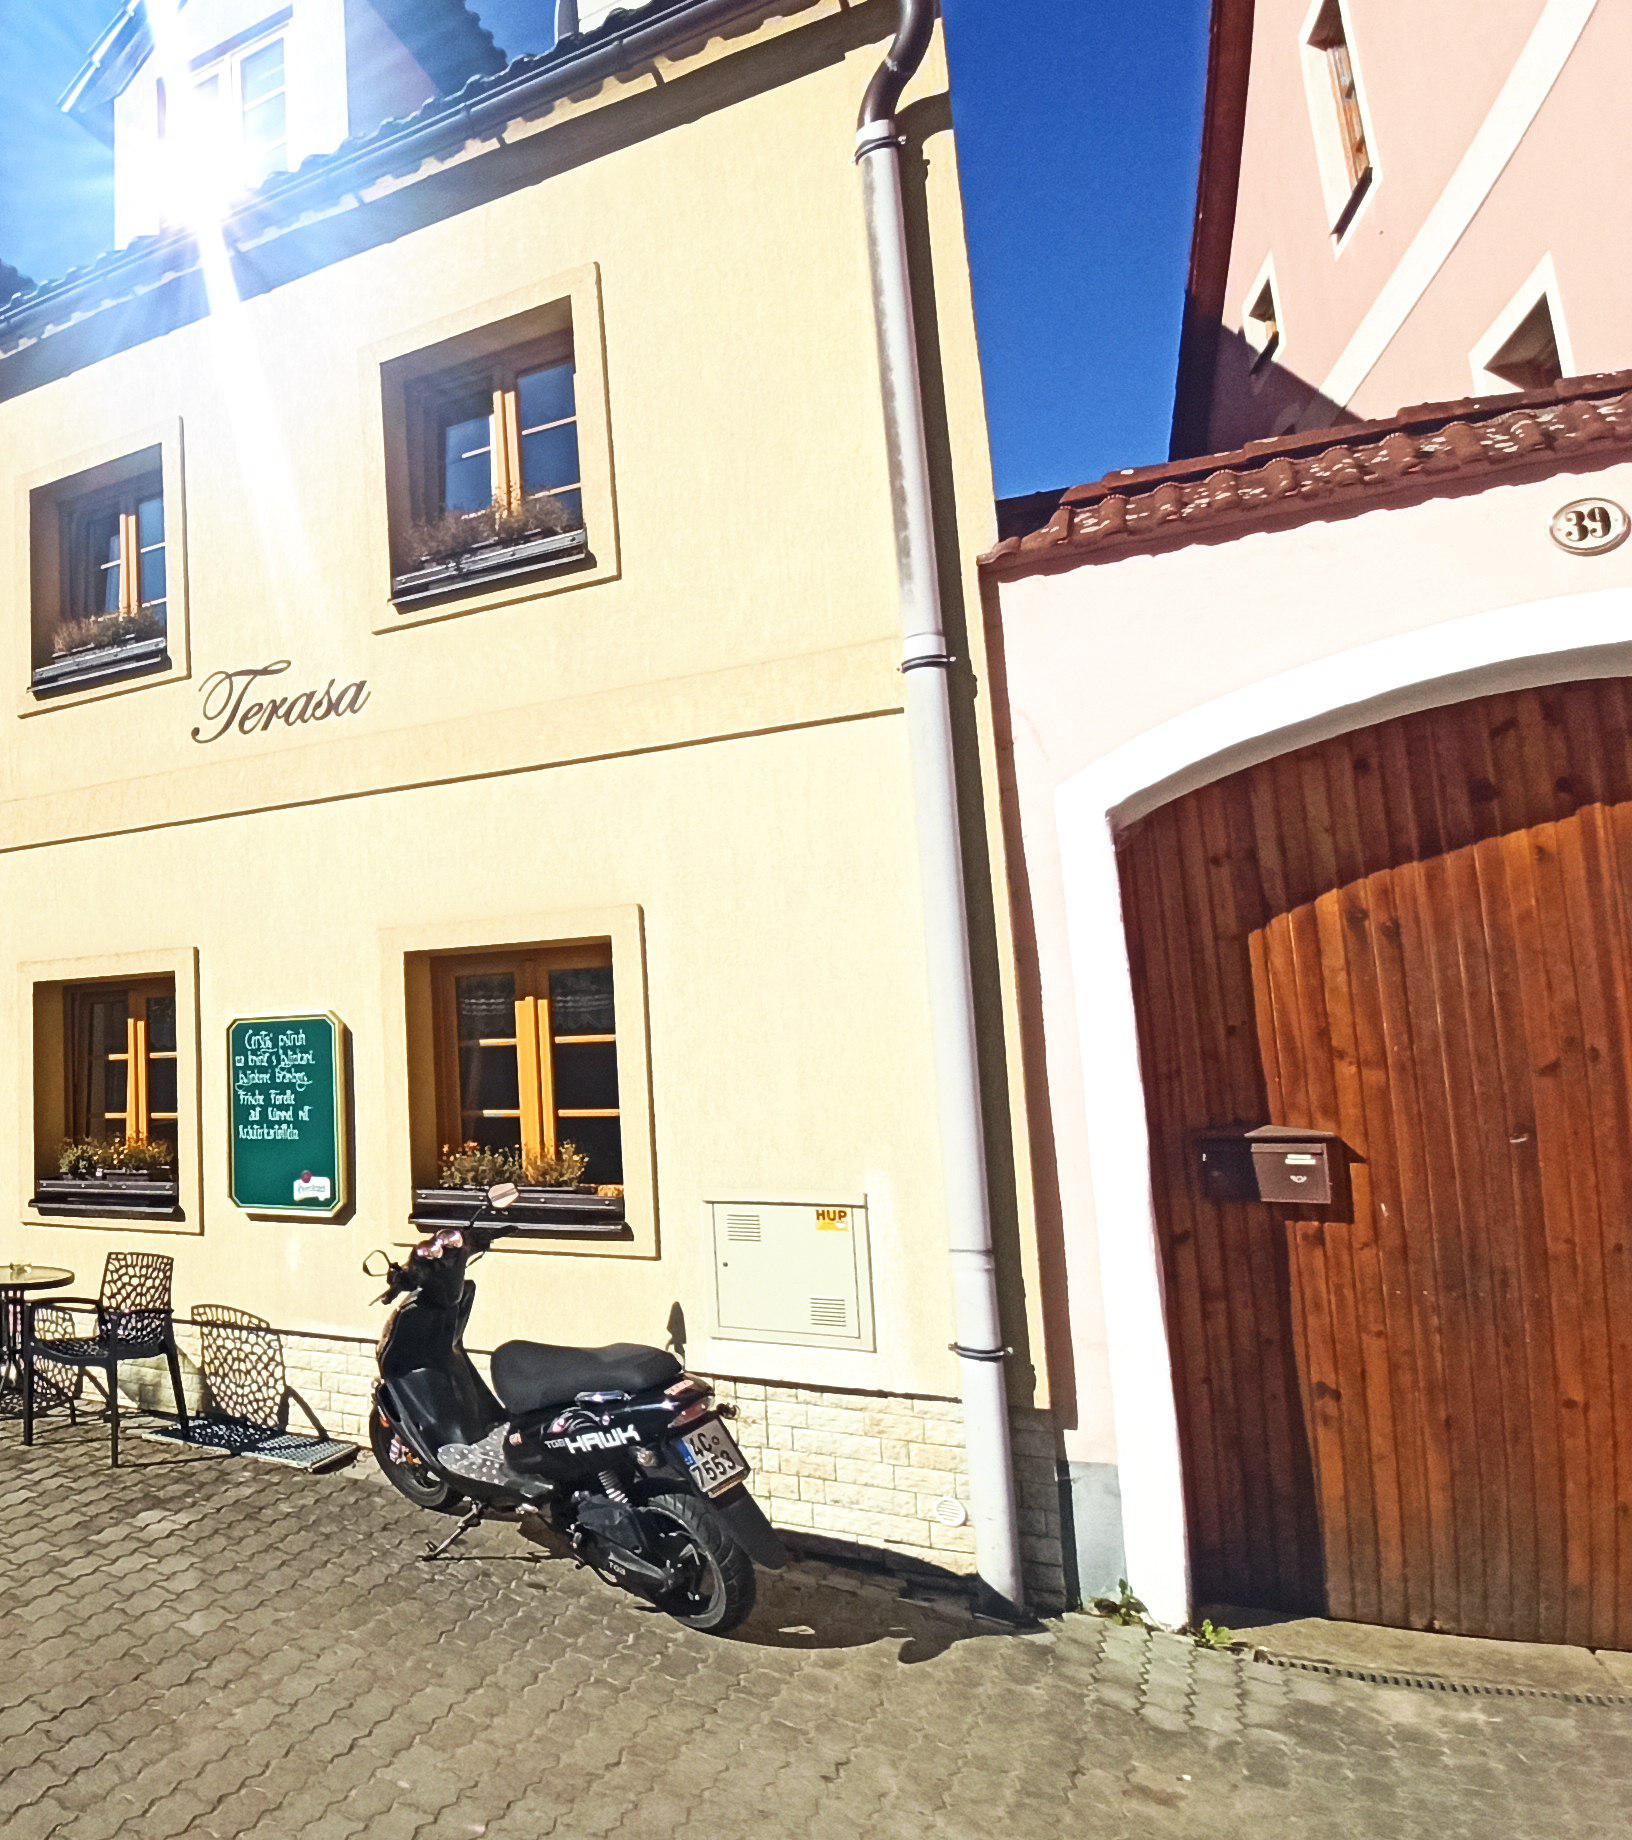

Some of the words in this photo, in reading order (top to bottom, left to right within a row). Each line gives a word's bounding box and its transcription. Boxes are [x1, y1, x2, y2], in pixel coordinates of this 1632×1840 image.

[1565, 506, 1612, 542] 39
[191, 659, 372, 744] Terasa
[815, 1209, 848, 1222] HUP
[564, 1423, 642, 1455] HAWK
[689, 1432, 713, 1458] 4C
[689, 1449, 737, 1488] 7553
